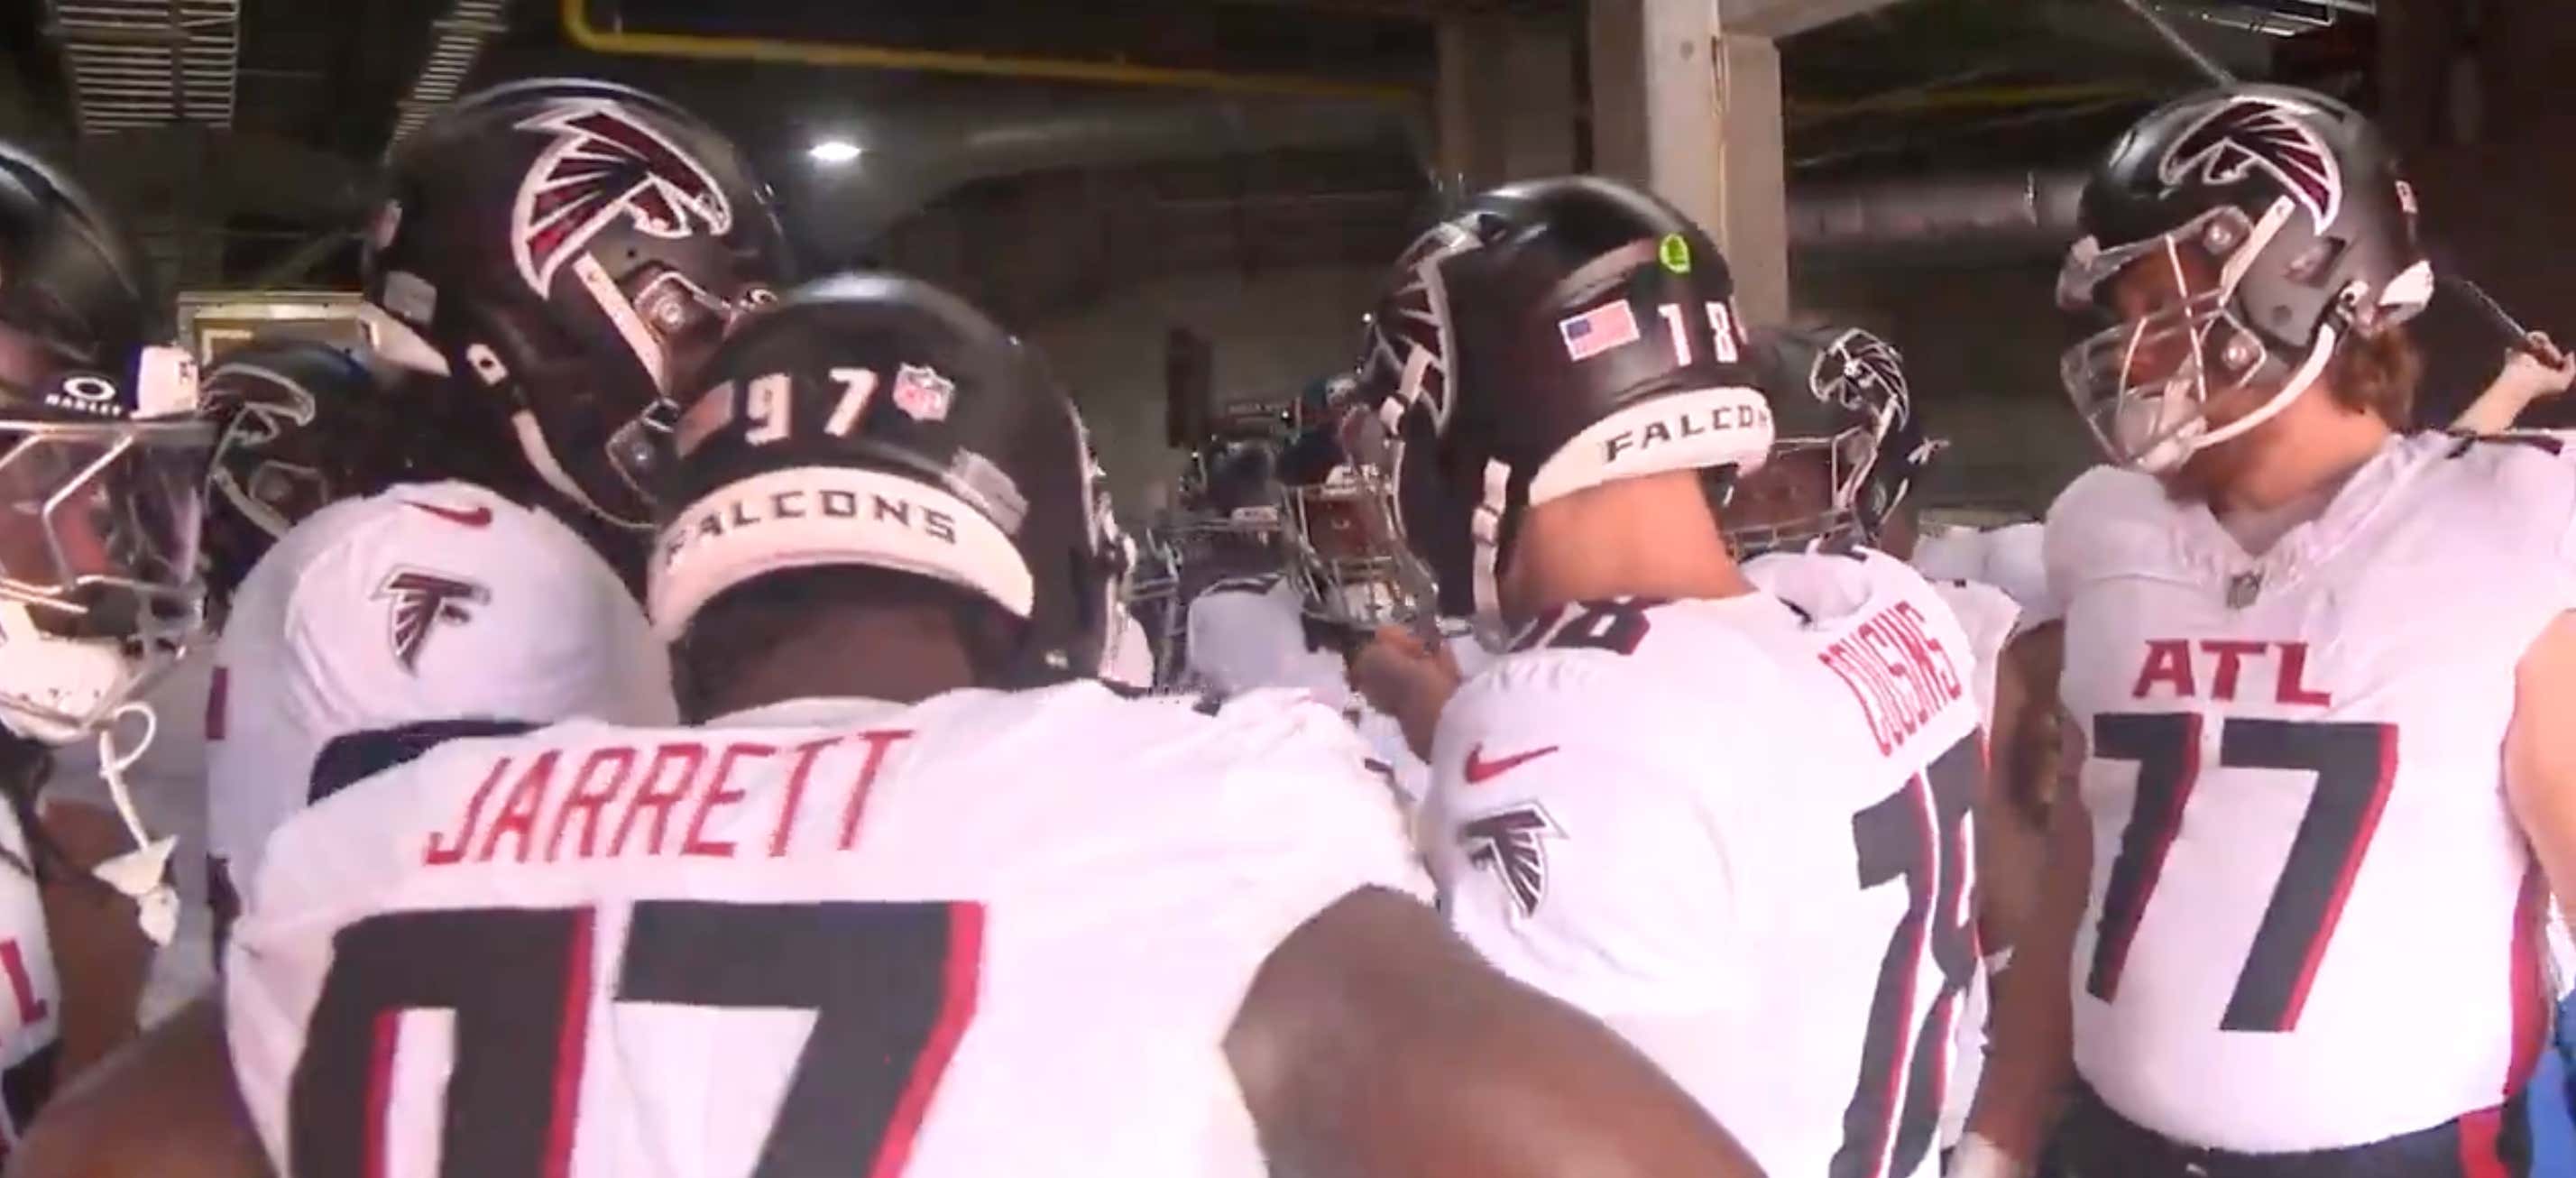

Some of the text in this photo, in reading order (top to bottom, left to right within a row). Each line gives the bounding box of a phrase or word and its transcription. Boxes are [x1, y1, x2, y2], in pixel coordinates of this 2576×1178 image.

[1658, 299, 1738, 367] 18
[1605, 404, 1768, 463] FALCO
[1817, 600, 1962, 757] COUSINS
[2131, 640, 2332, 707] ATL
[422, 728, 915, 866] JARRETT
[2086, 711, 2399, 1033] 77
